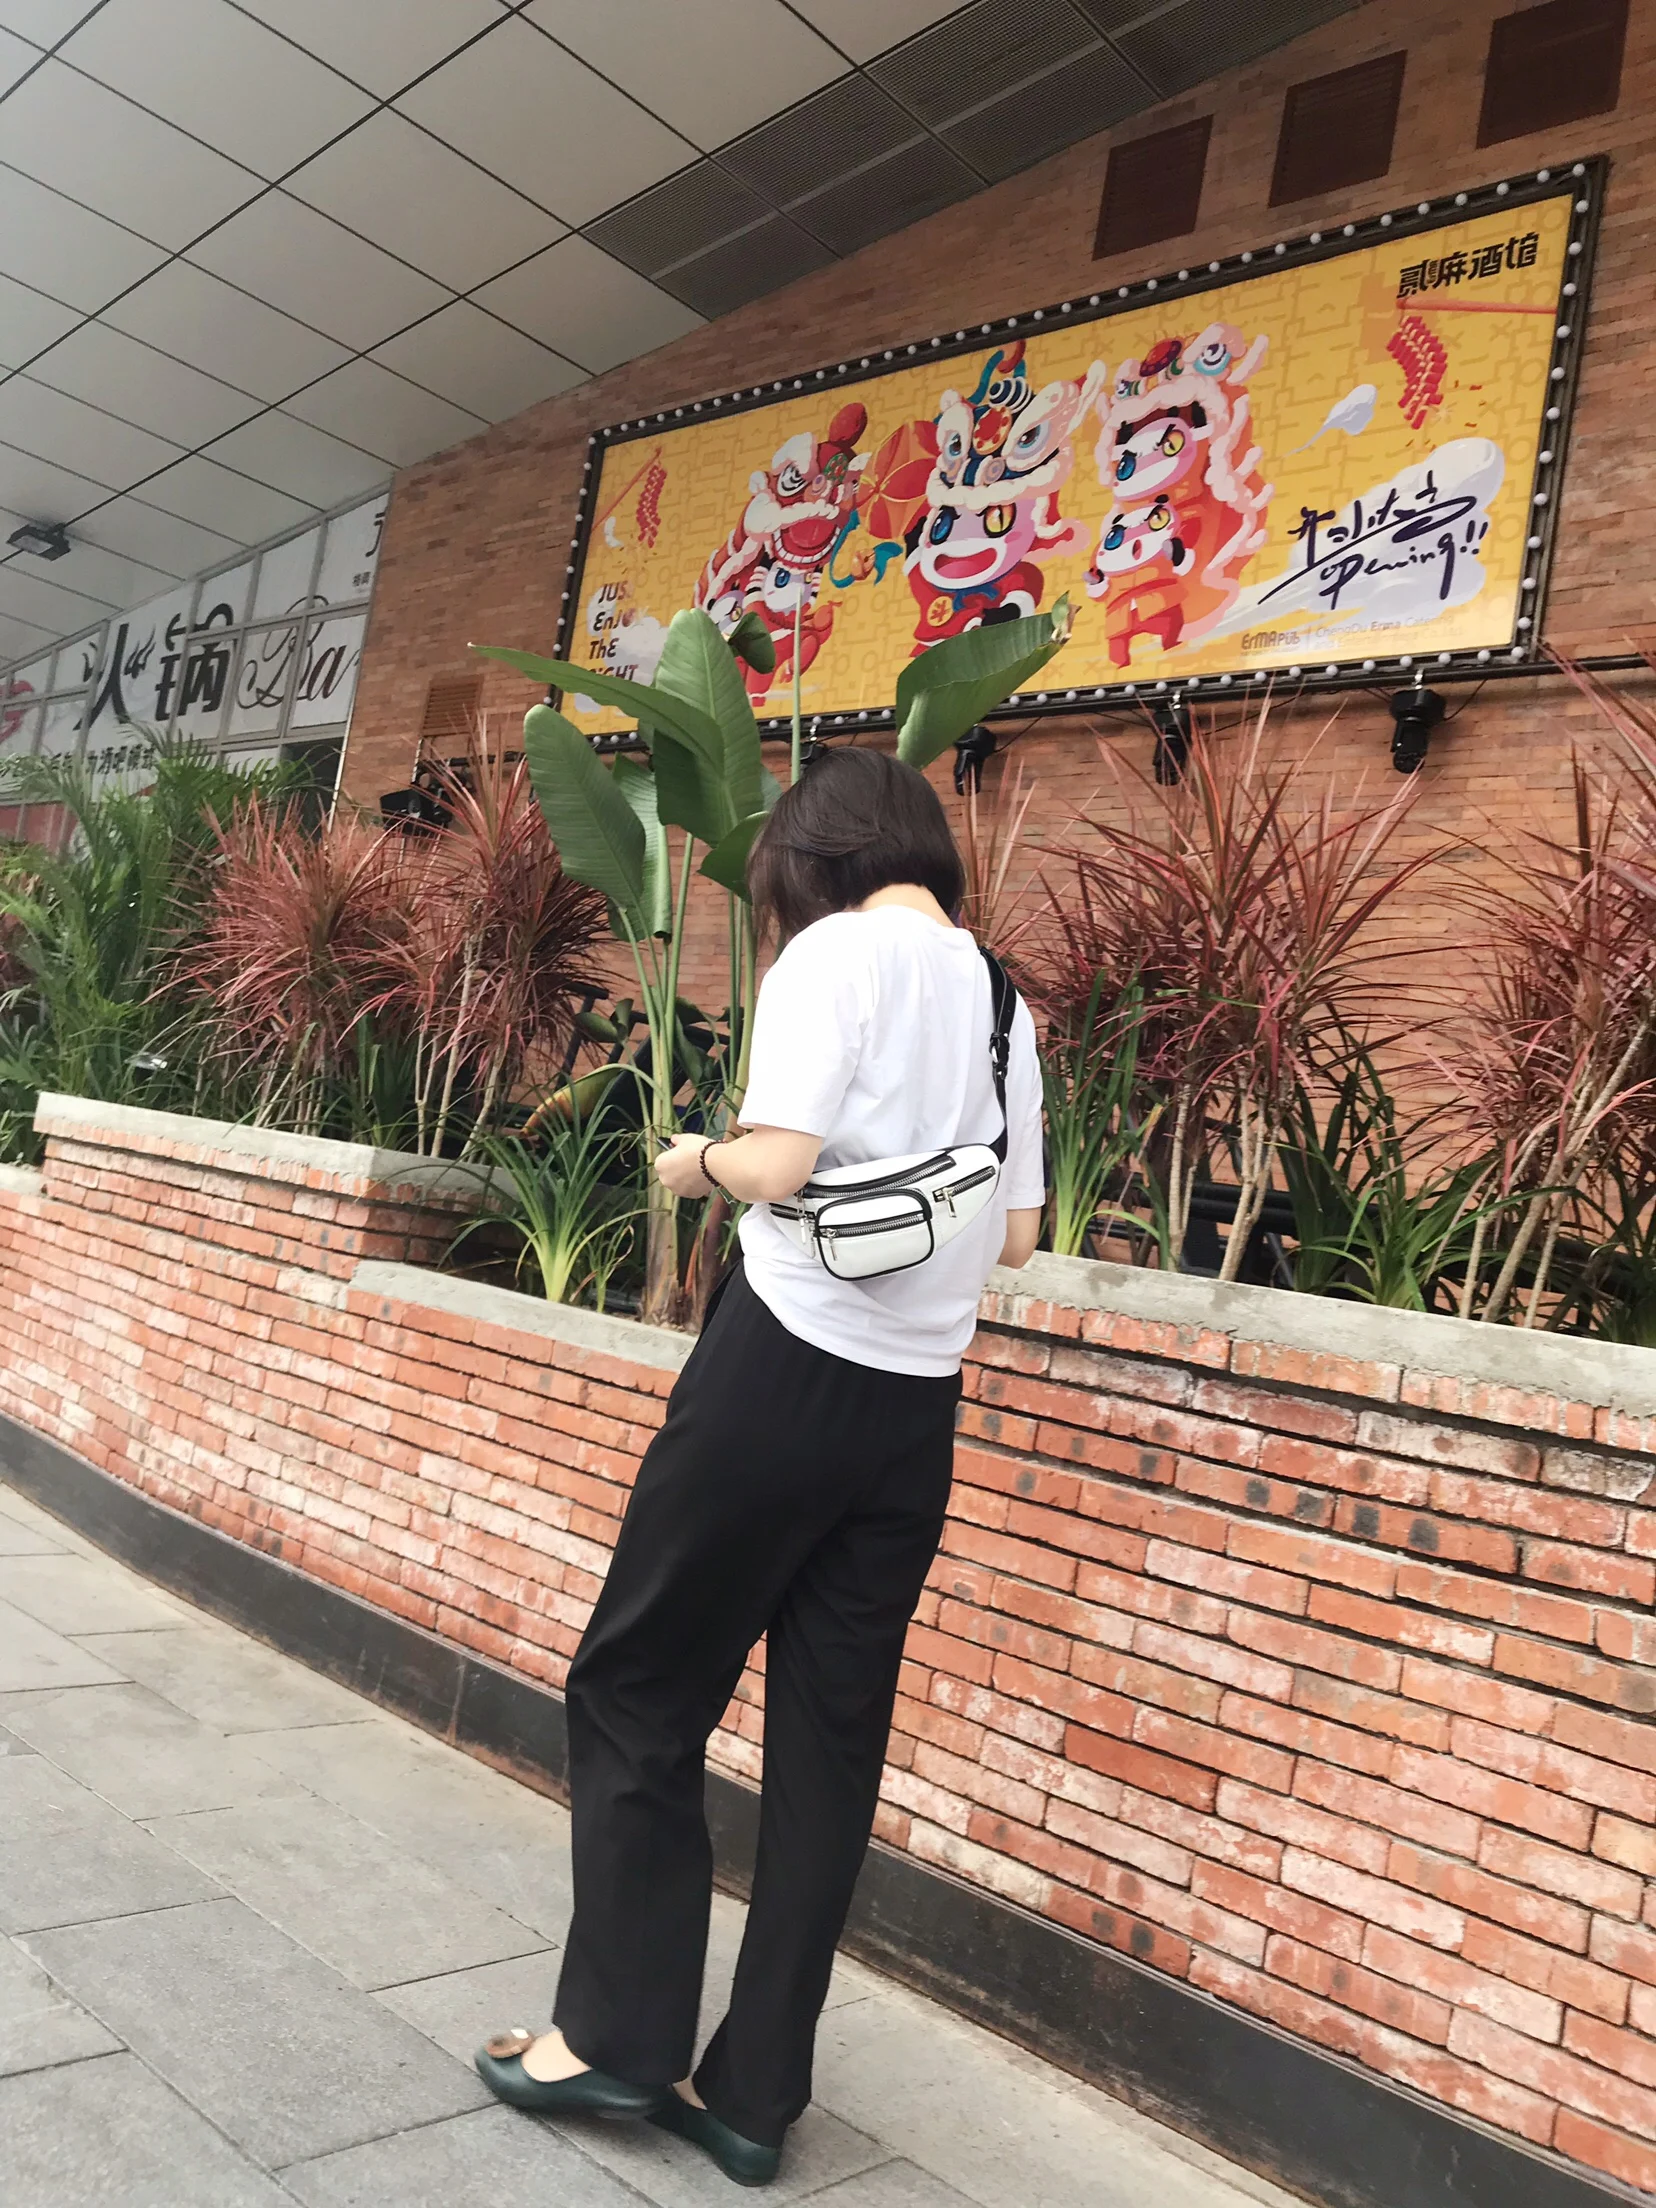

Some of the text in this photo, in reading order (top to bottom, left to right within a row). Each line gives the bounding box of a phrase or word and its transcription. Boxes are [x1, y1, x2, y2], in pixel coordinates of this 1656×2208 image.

[1396, 232, 1540, 299] 贰麻酒馆
[73, 603, 234, 731] 火锅
